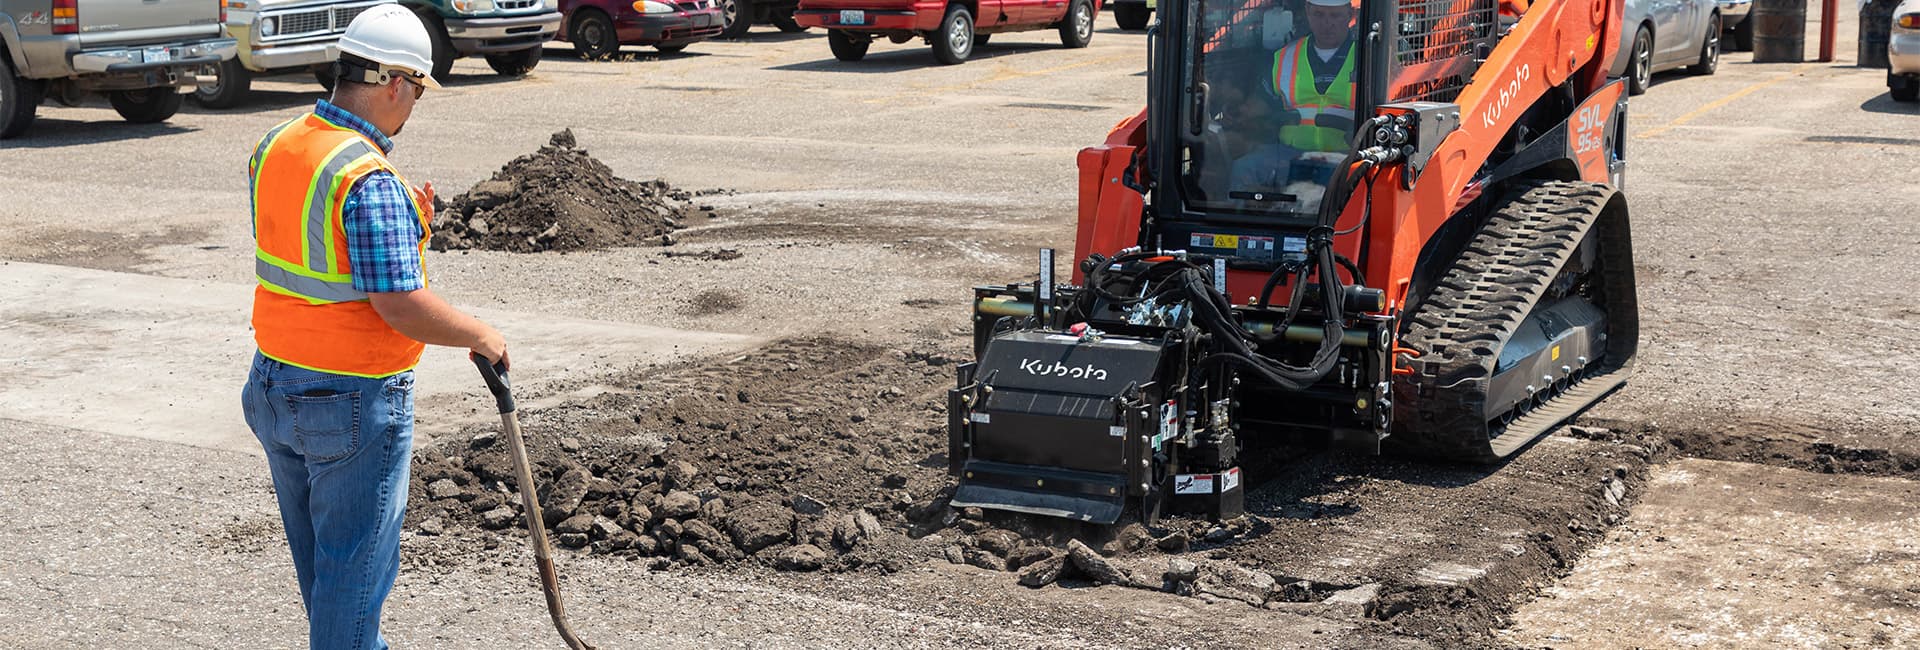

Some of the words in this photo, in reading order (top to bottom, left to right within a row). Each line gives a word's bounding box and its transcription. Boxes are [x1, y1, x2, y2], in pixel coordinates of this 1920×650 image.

[1482, 63, 1530, 129] Kubota
[1577, 104, 1604, 133] SVL
[1019, 358, 1108, 381] Kubota
